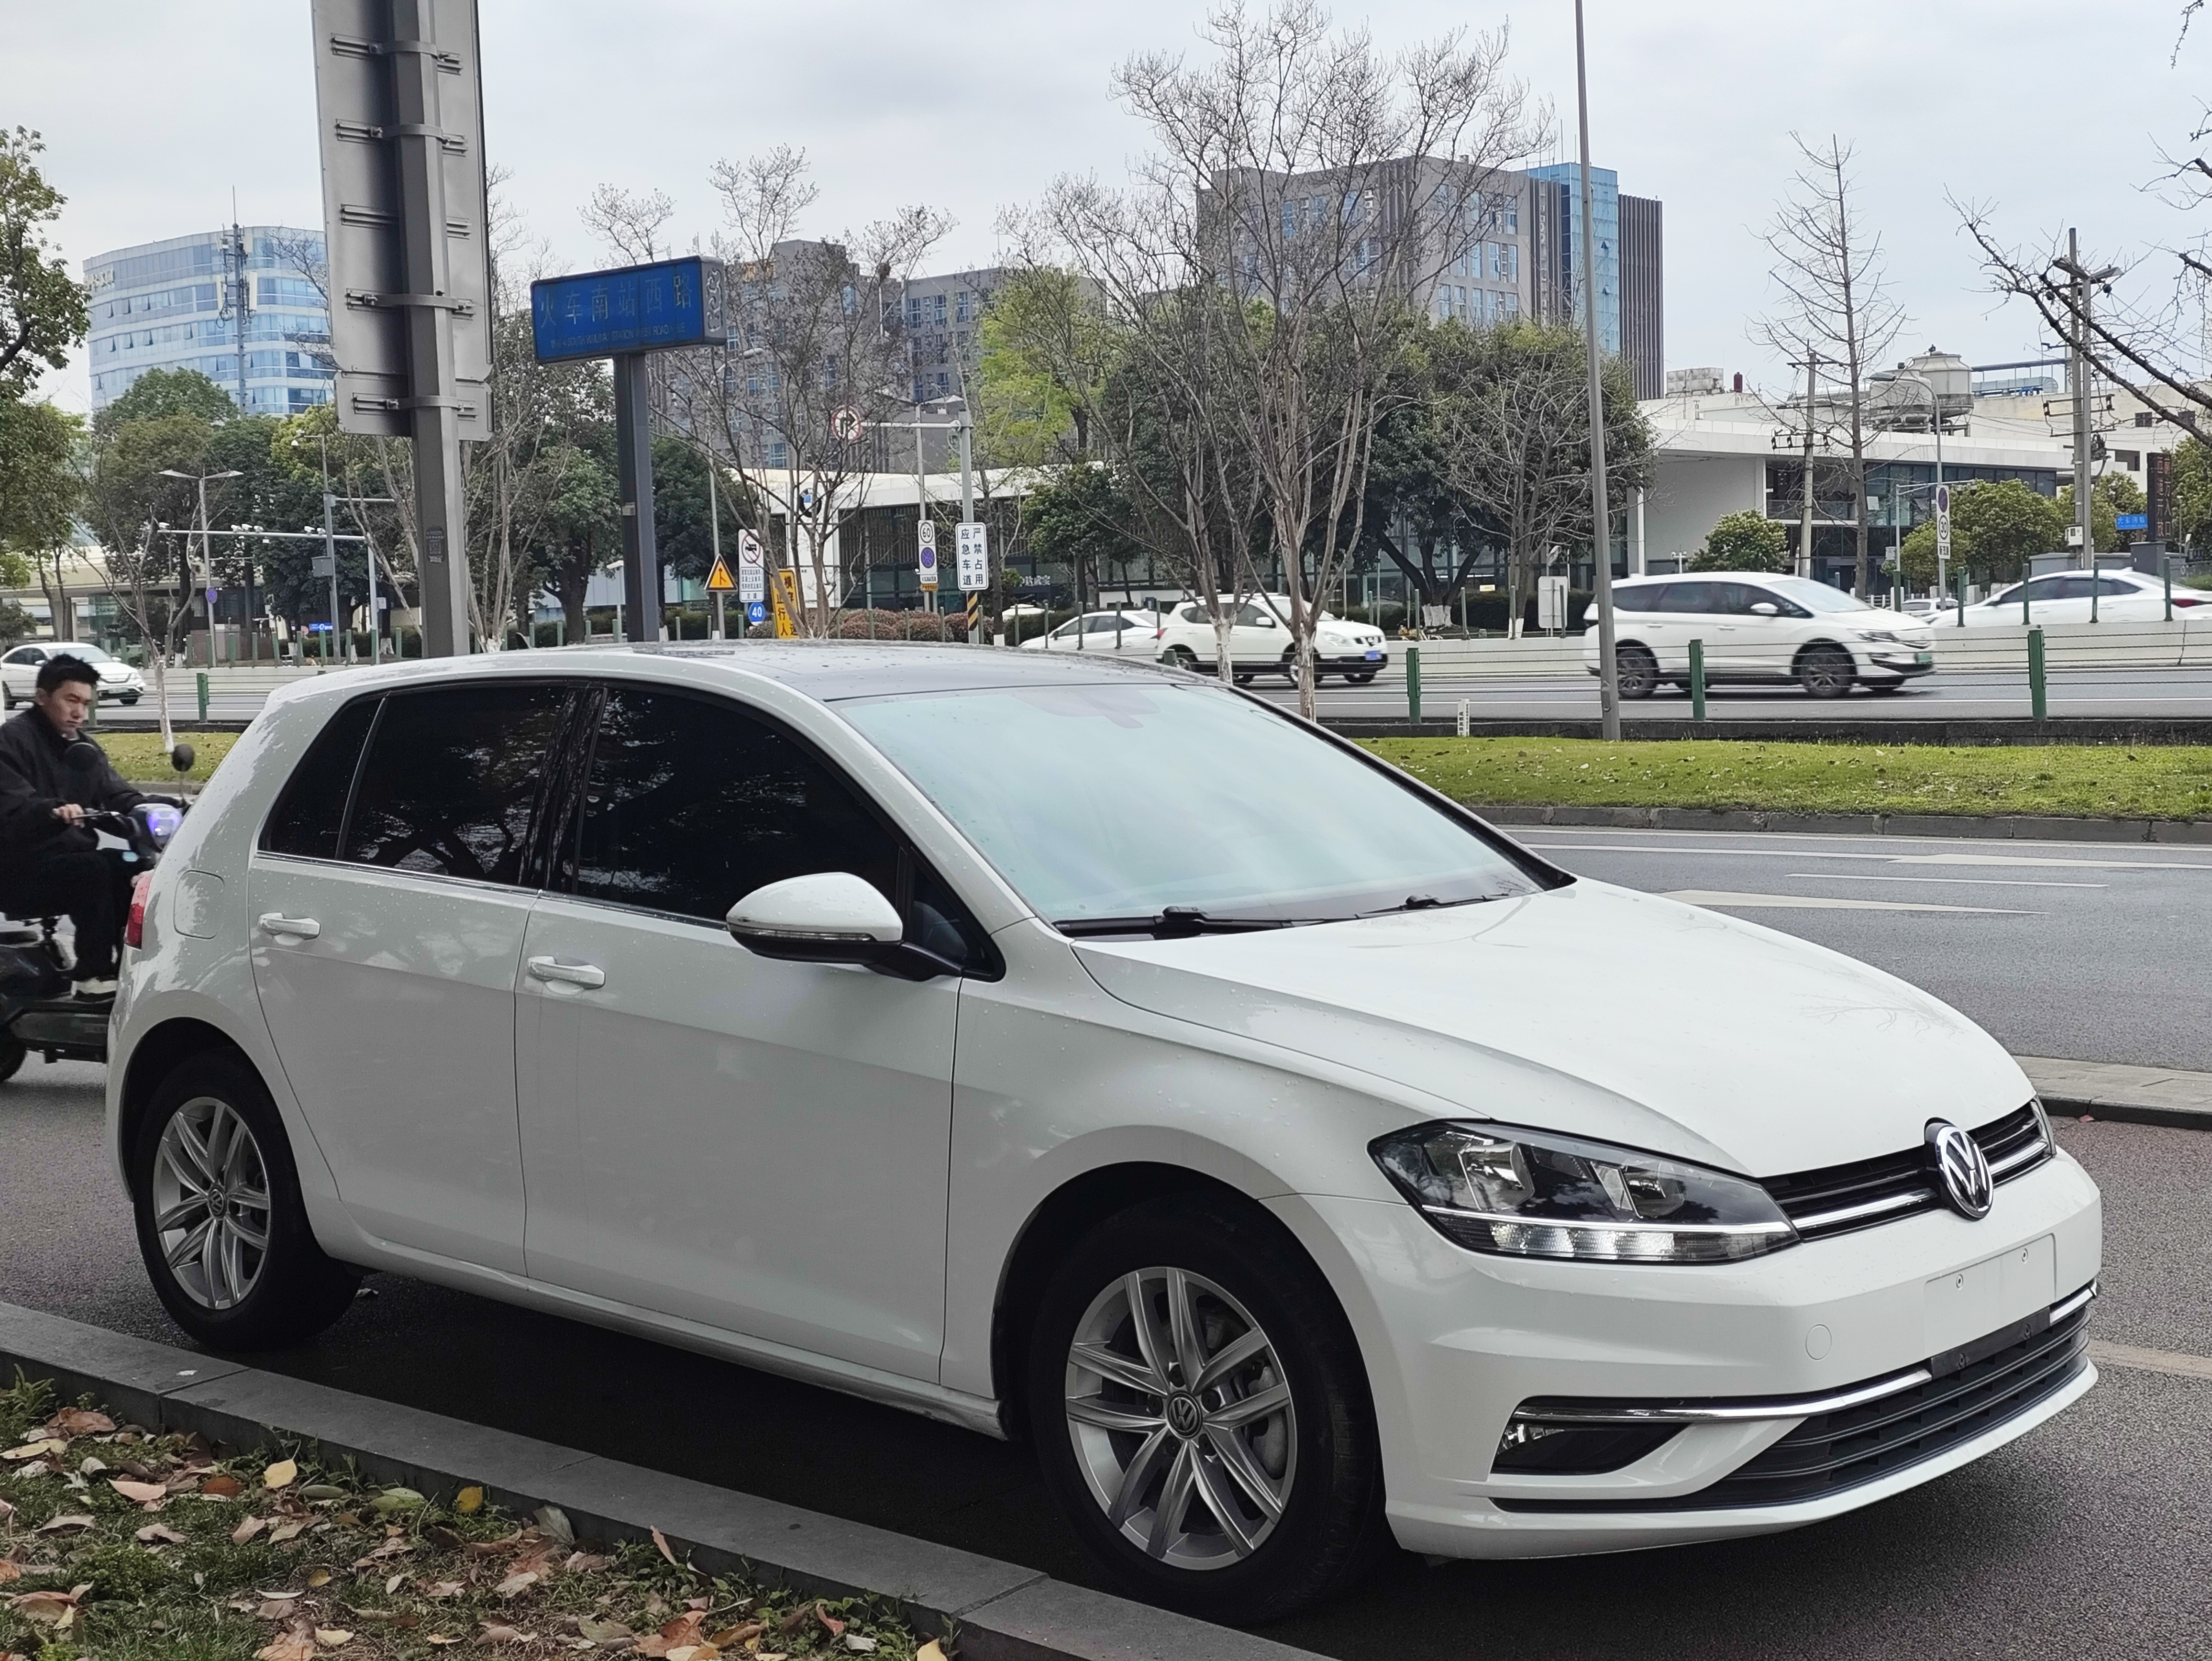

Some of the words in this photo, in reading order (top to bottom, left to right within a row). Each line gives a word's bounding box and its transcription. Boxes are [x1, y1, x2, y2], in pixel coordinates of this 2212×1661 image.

[541, 273, 692, 328] 火车南站西路
[922, 527, 931, 538] 60
[1941, 521, 1947, 533] 30
[961, 528, 972, 586] 应急车道
[973, 527, 984, 585] 严禁占用
[752, 606, 762, 618] 40
[776, 592, 789, 636] 止行人
